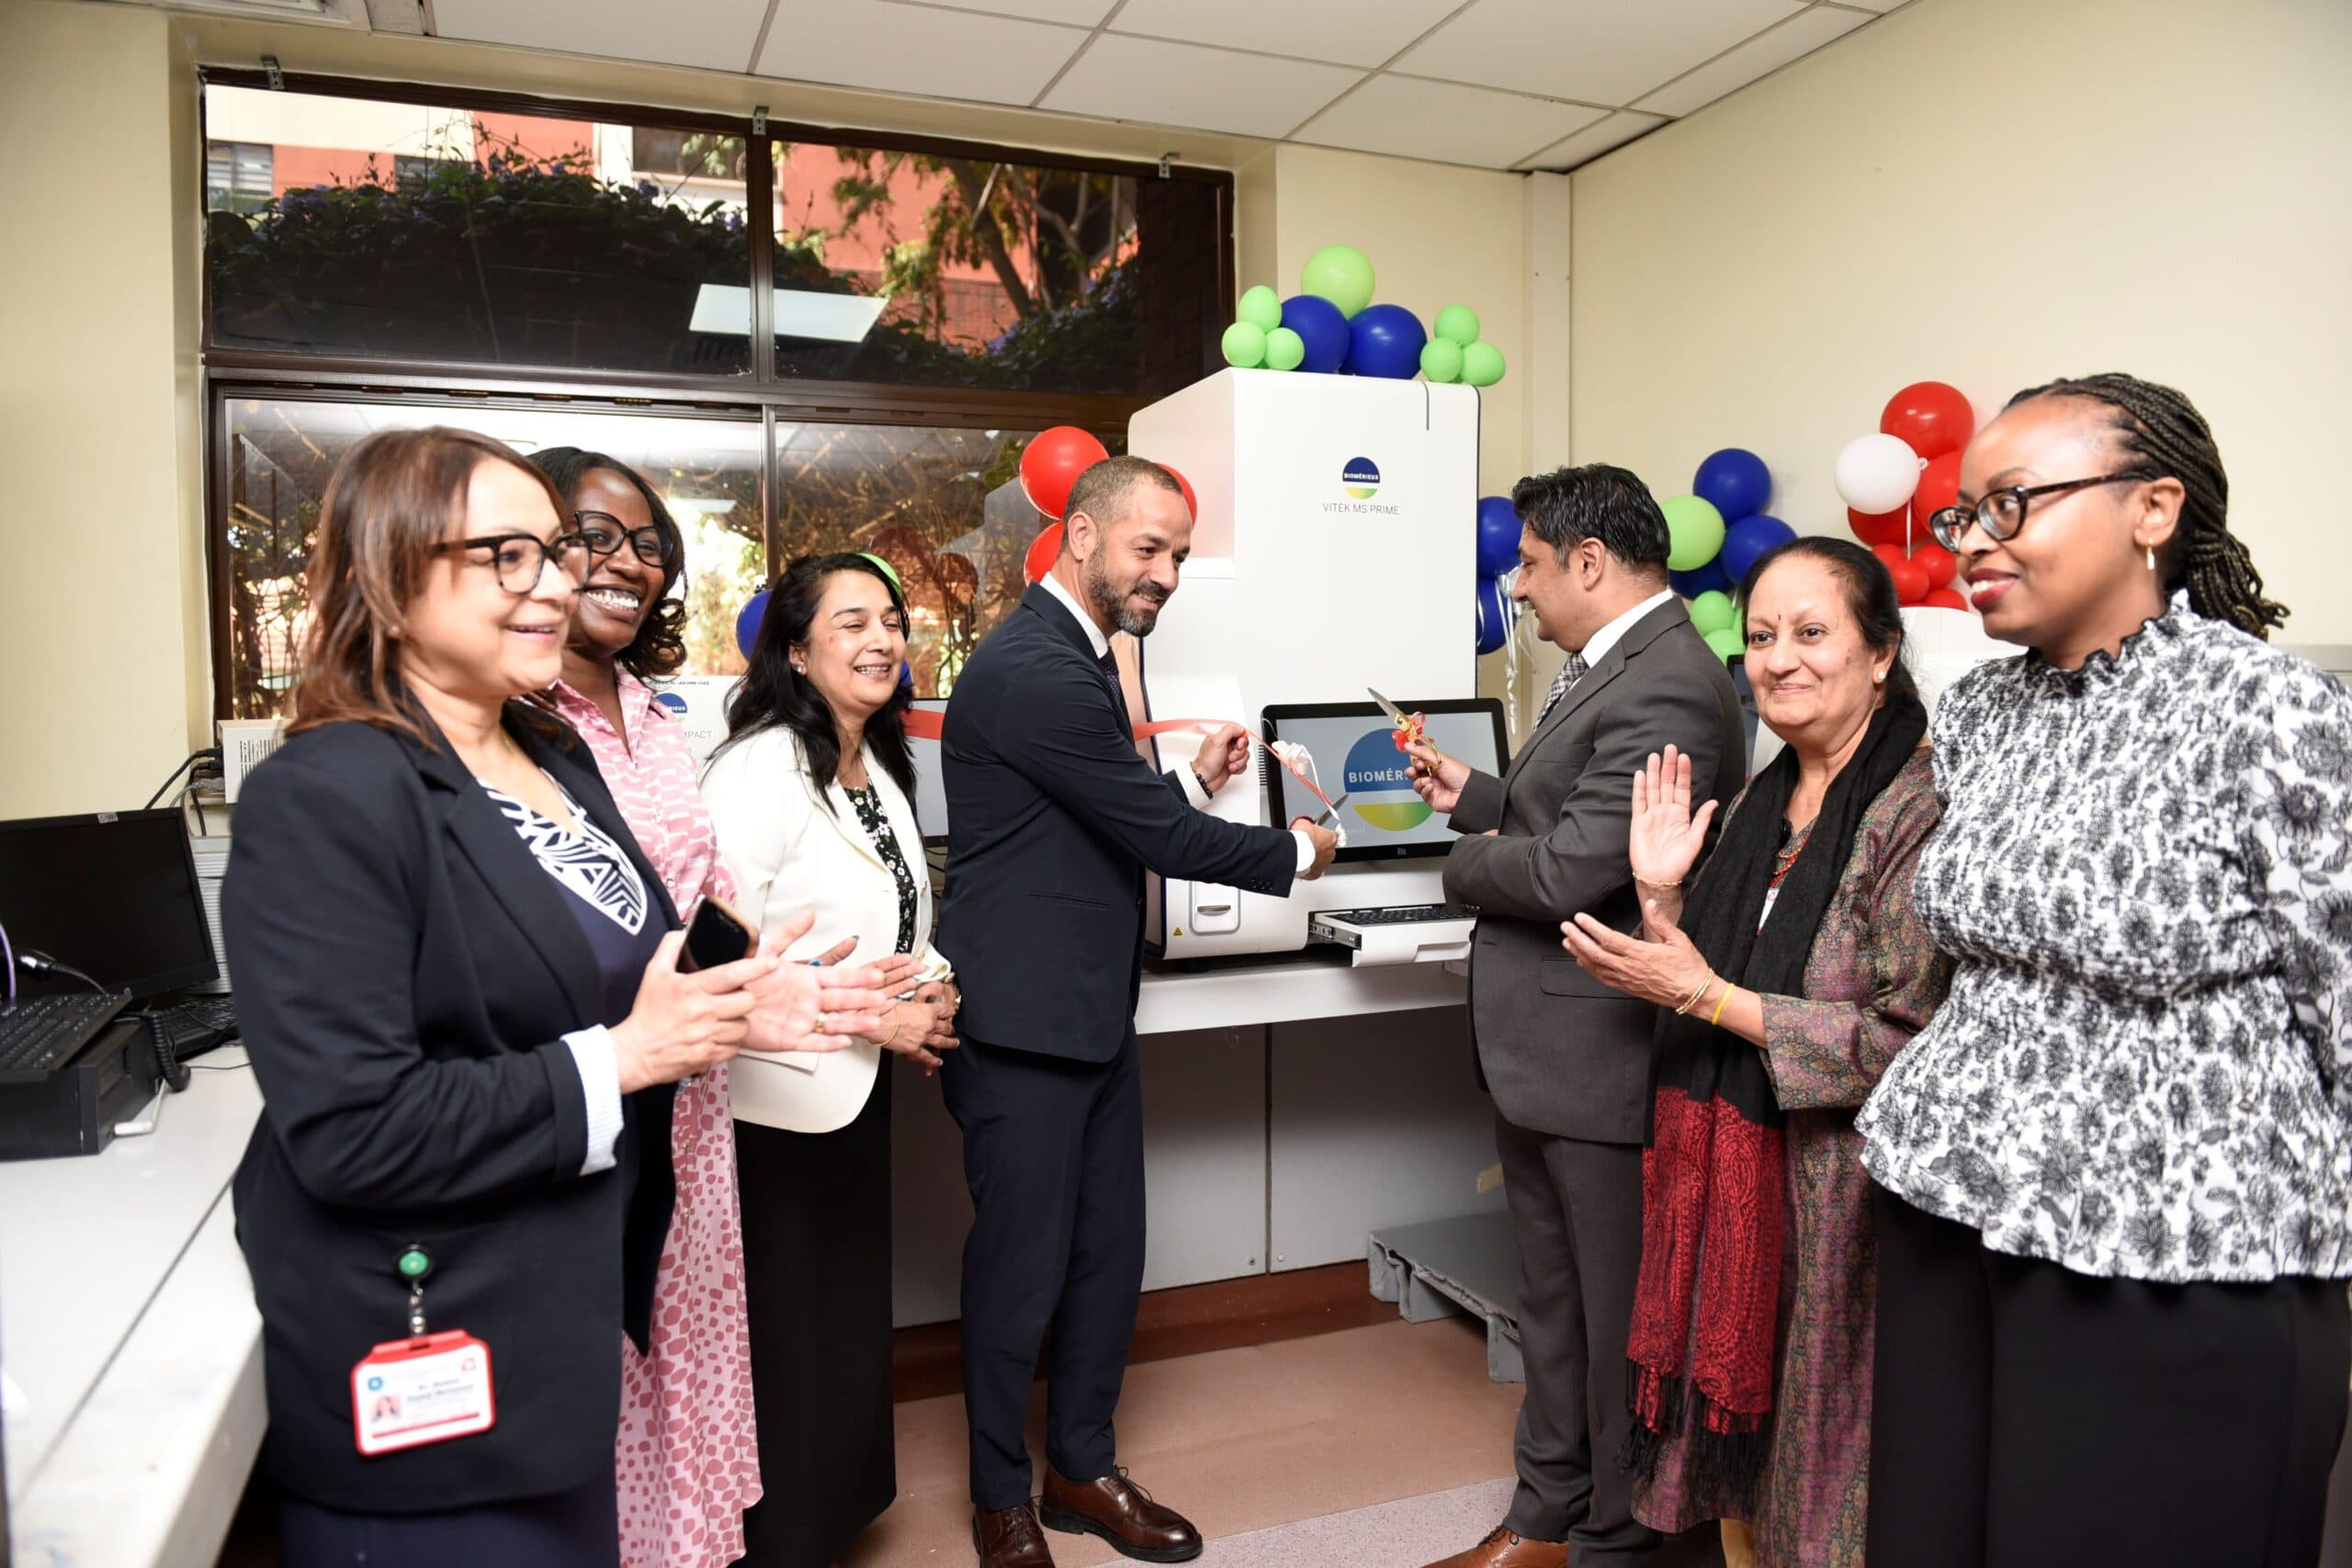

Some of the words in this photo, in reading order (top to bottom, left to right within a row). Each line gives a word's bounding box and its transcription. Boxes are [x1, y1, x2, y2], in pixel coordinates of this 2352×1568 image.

[1323, 502, 1351, 513] VITEK
[1352, 503, 1368, 514] MS
[1370, 504, 1400, 515] PRIME
[1349, 768, 1408, 784] BIOMÉR
